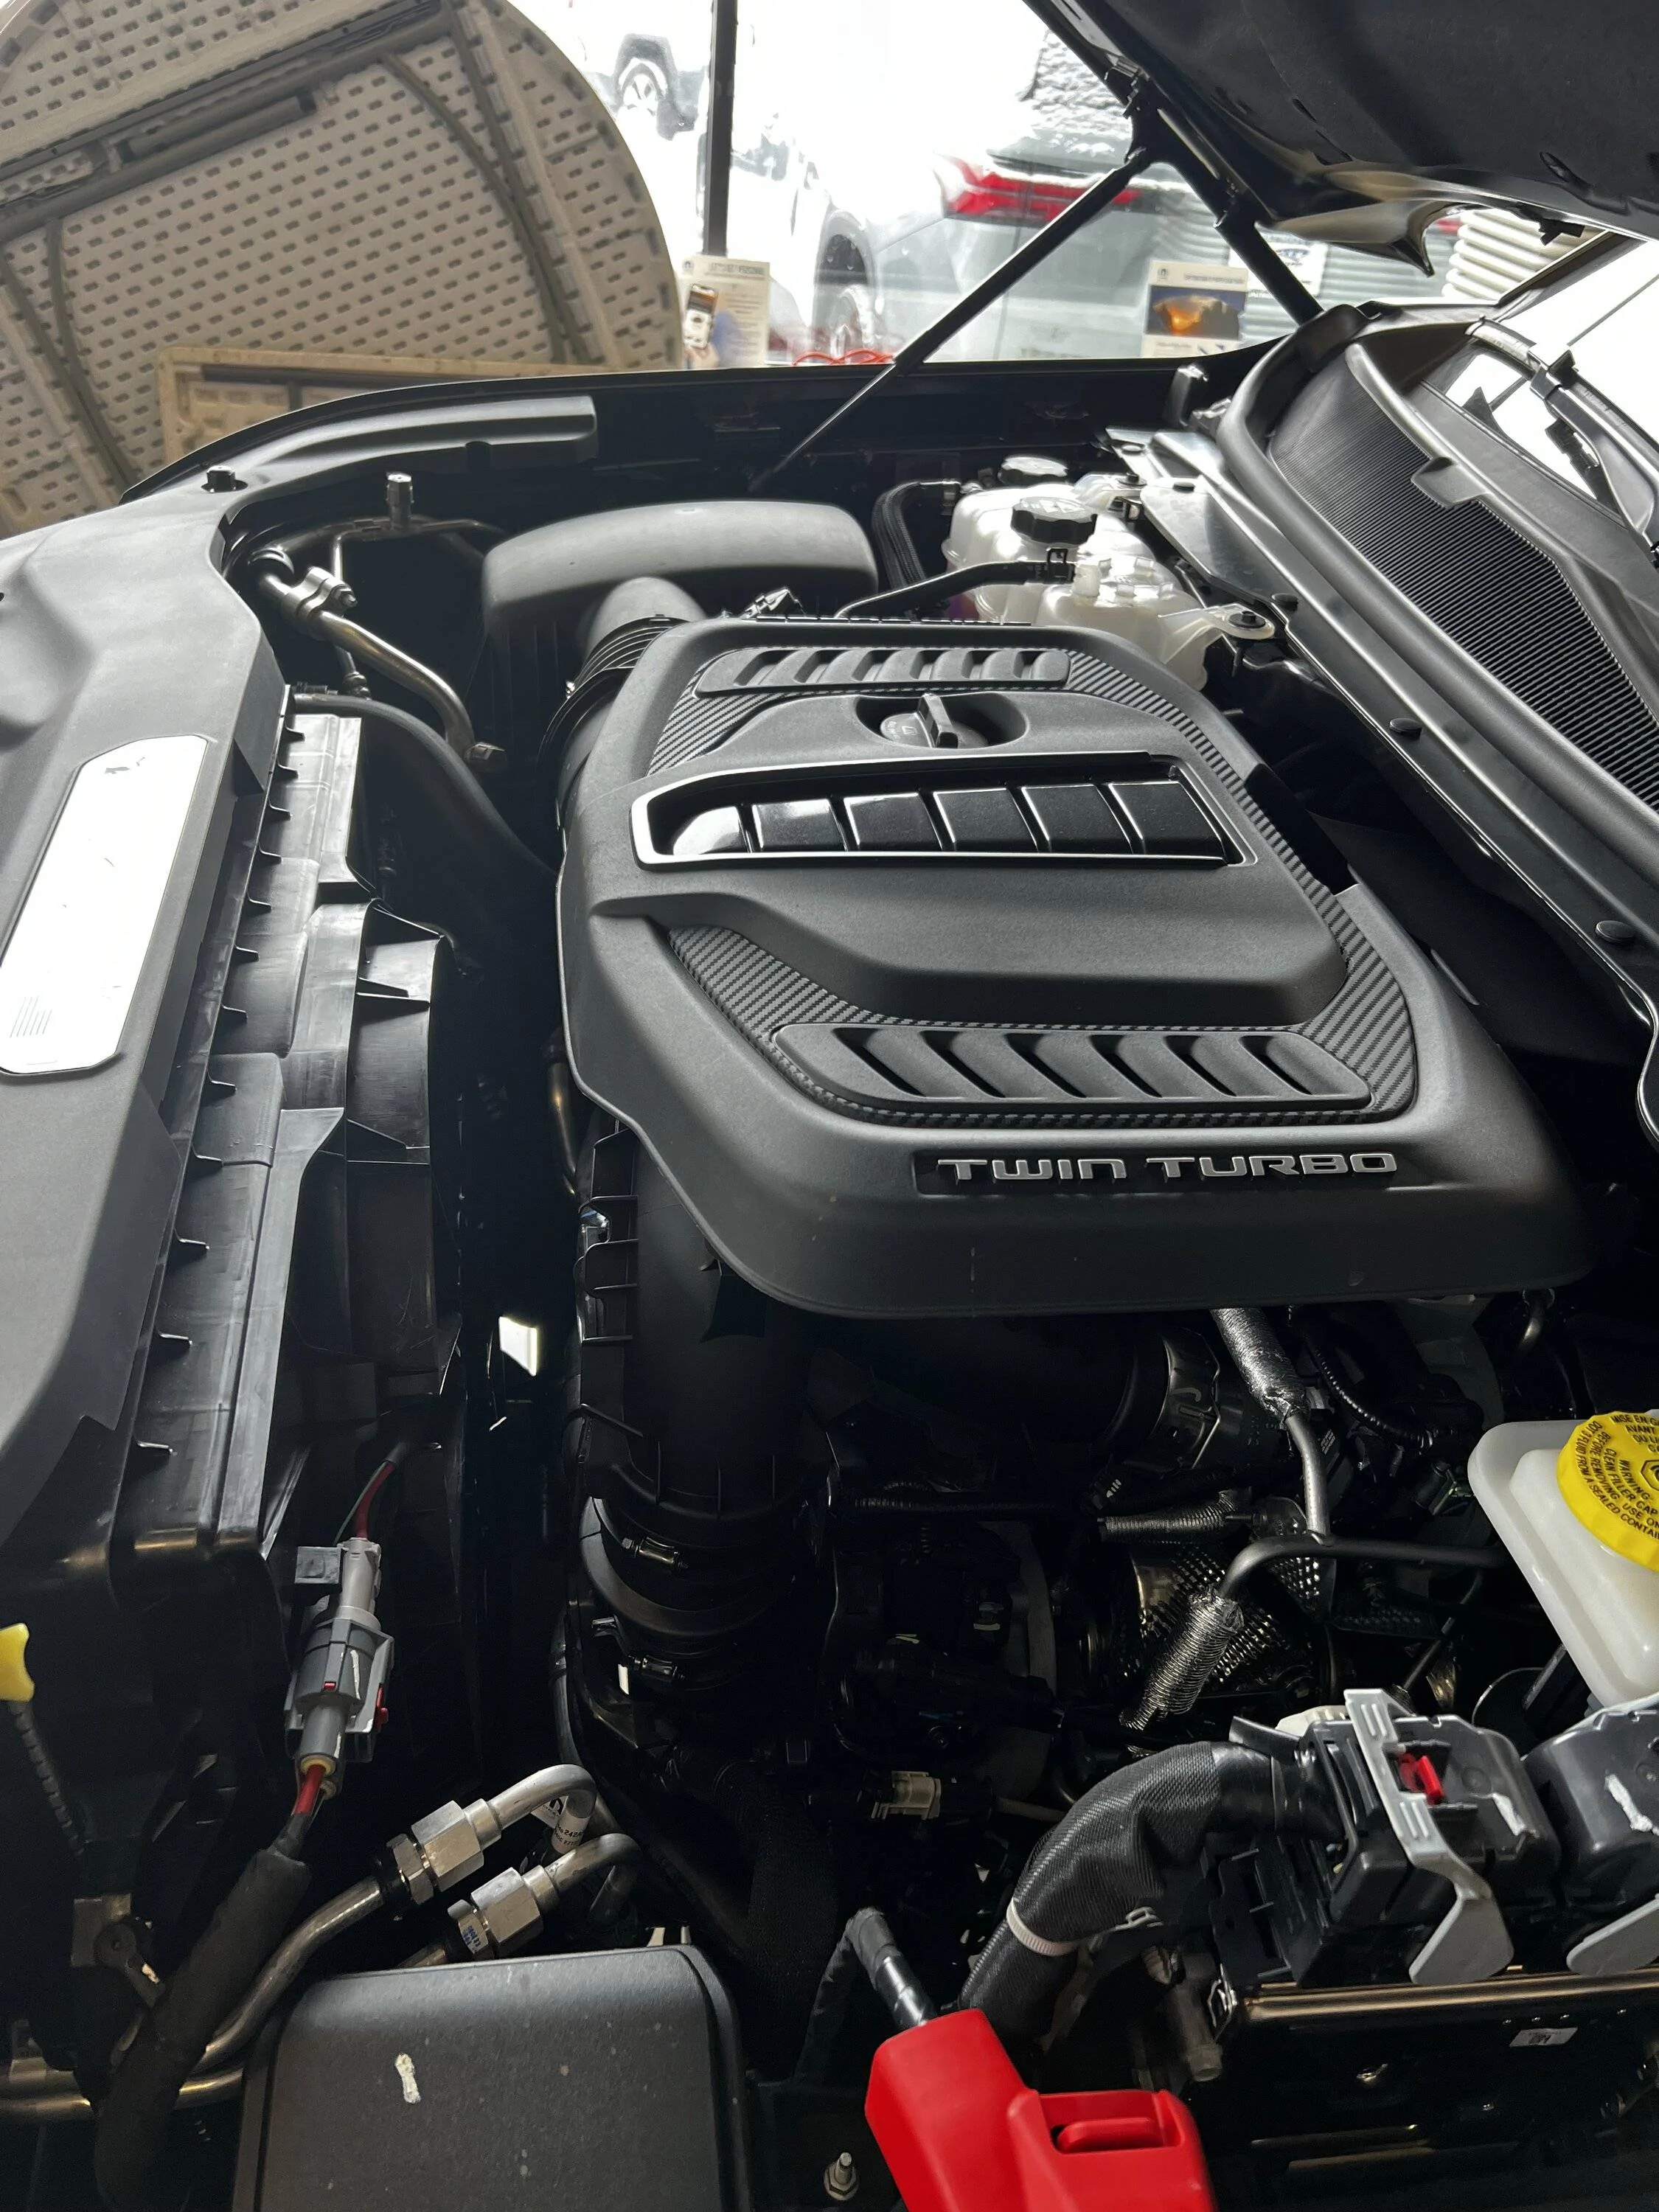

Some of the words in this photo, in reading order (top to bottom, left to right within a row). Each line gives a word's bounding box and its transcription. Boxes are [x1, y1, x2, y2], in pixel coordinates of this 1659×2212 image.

[937, 1158, 1127, 1180] TWIN
[1147, 1152, 1397, 1178] TURBO
[1585, 1420, 1603, 1434] DOT
[1610, 1414, 1632, 1424] MISE
[1633, 1414, 1647, 1424] EN
[1625, 1425, 1655, 1434] AVANT
[1576, 1435, 1589, 1455] FLUID
[1576, 1455, 1591, 1475] FROM
[1604, 1447, 1617, 1472] CLEAN
[1590, 1431, 1611, 1456] BEFORE
[1622, 1503, 1644, 1520] USE
[1607, 1473, 1636, 1501] FILLER
[1589, 1485, 1621, 1514] SEALED
[1636, 1500, 1658, 1515] CAP
